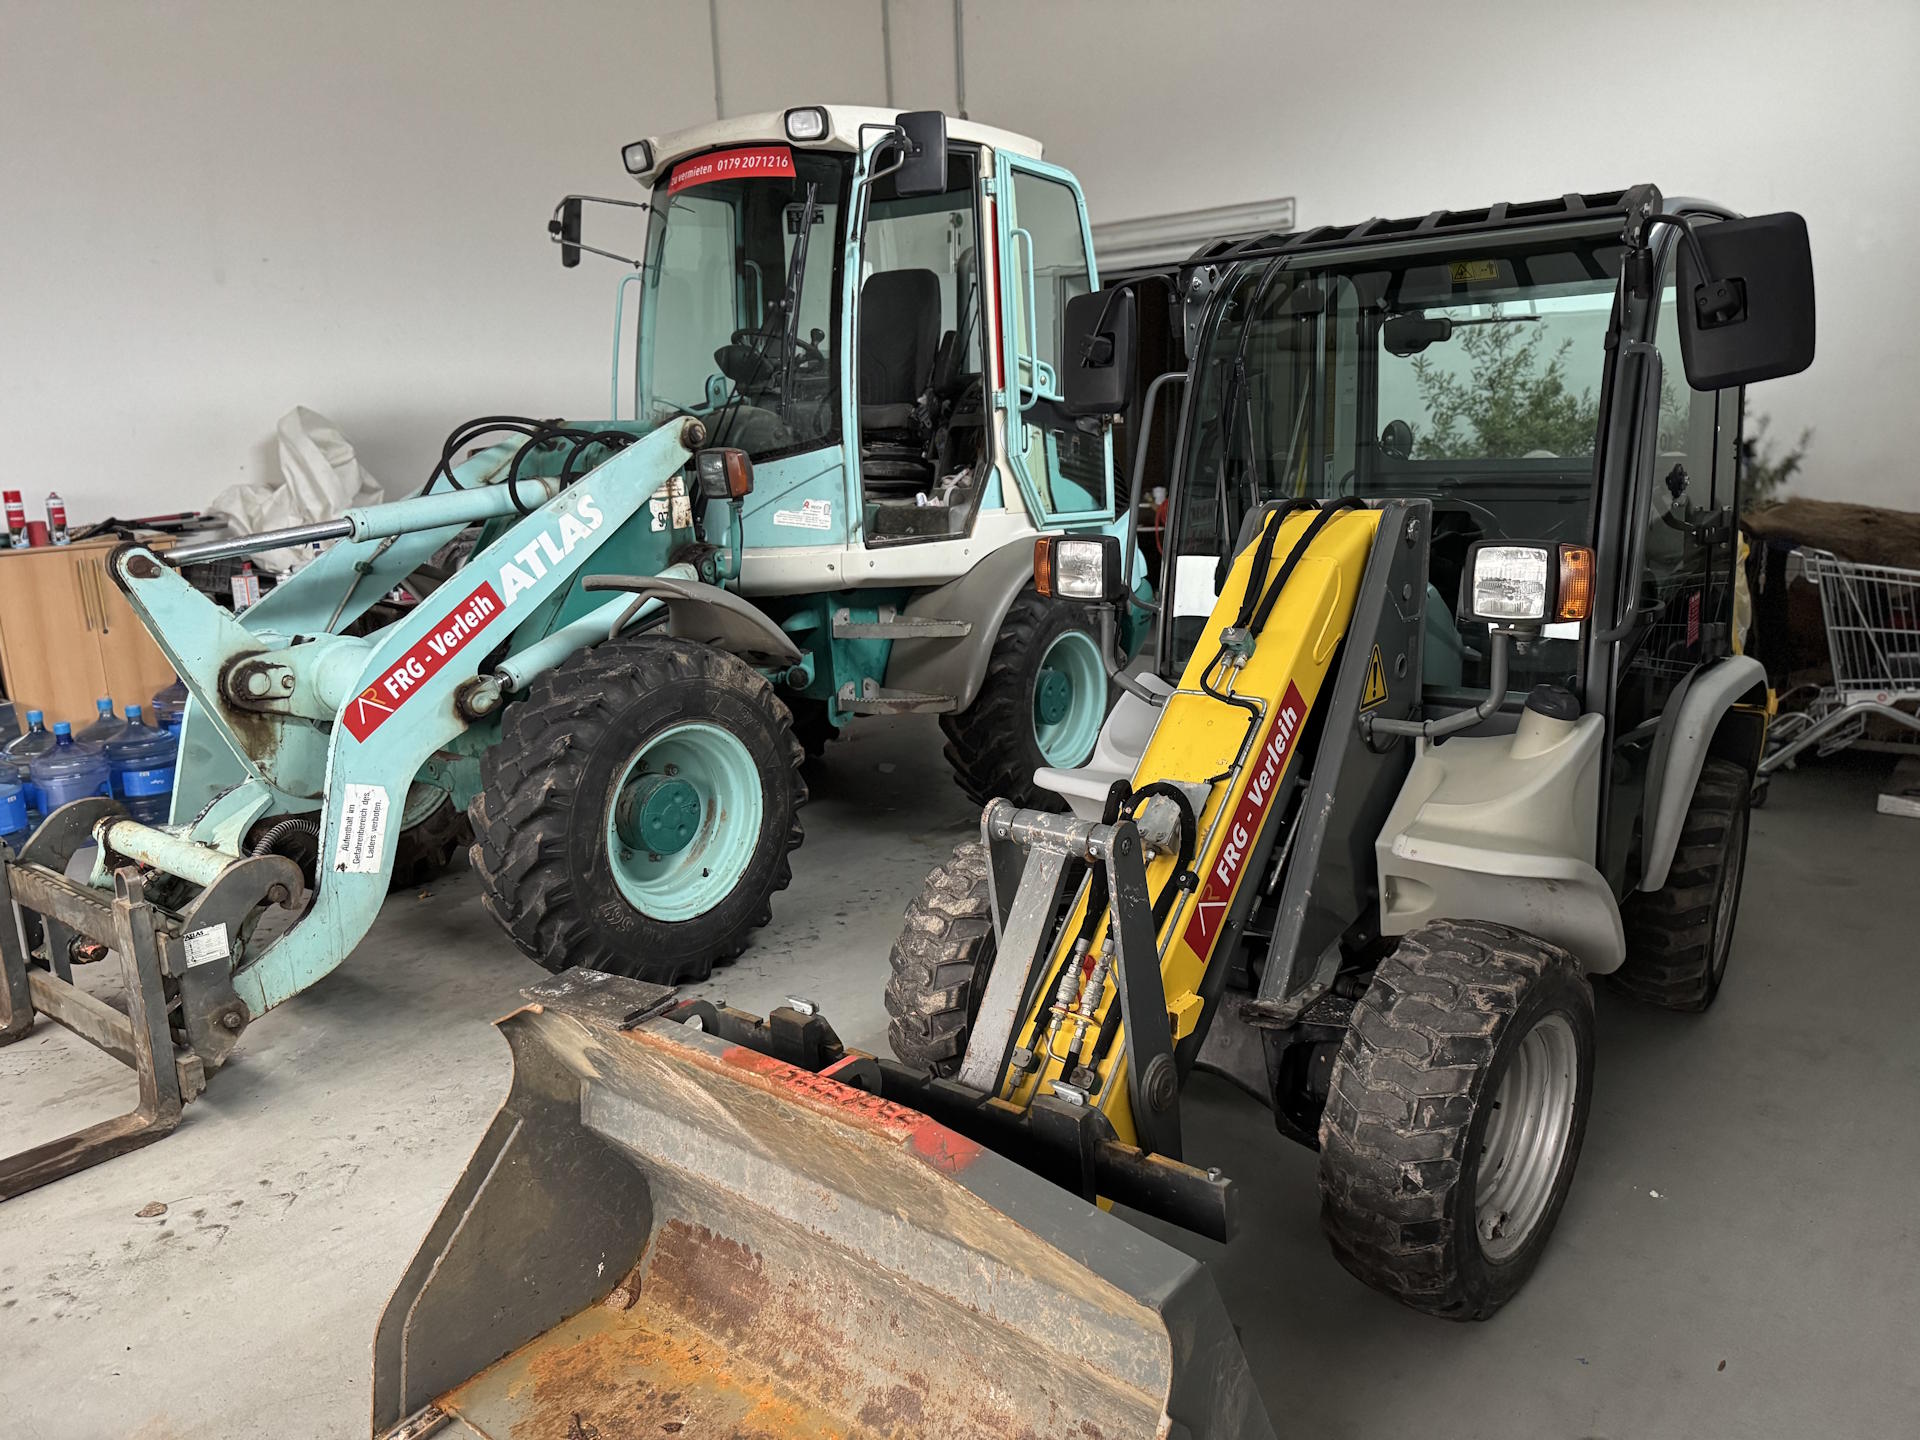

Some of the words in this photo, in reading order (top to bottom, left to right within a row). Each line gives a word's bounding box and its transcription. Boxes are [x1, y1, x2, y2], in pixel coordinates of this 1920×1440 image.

[678, 163, 713, 182] vermieten
[717, 158, 741, 171] 0179
[742, 155, 789, 168] 2071216
[499, 494, 604, 606] ATLAS
[383, 656, 426, 700] FRG
[427, 595, 496, 657] Verleih
[347, 804, 356, 814] im
[1216, 822, 1249, 887] FRG
[1247, 705, 1298, 808] Verleih
[341, 816, 354, 852] Aufenthalt
[352, 808, 368, 865] Gefahrenbereich
[366, 834, 377, 859] Laders
